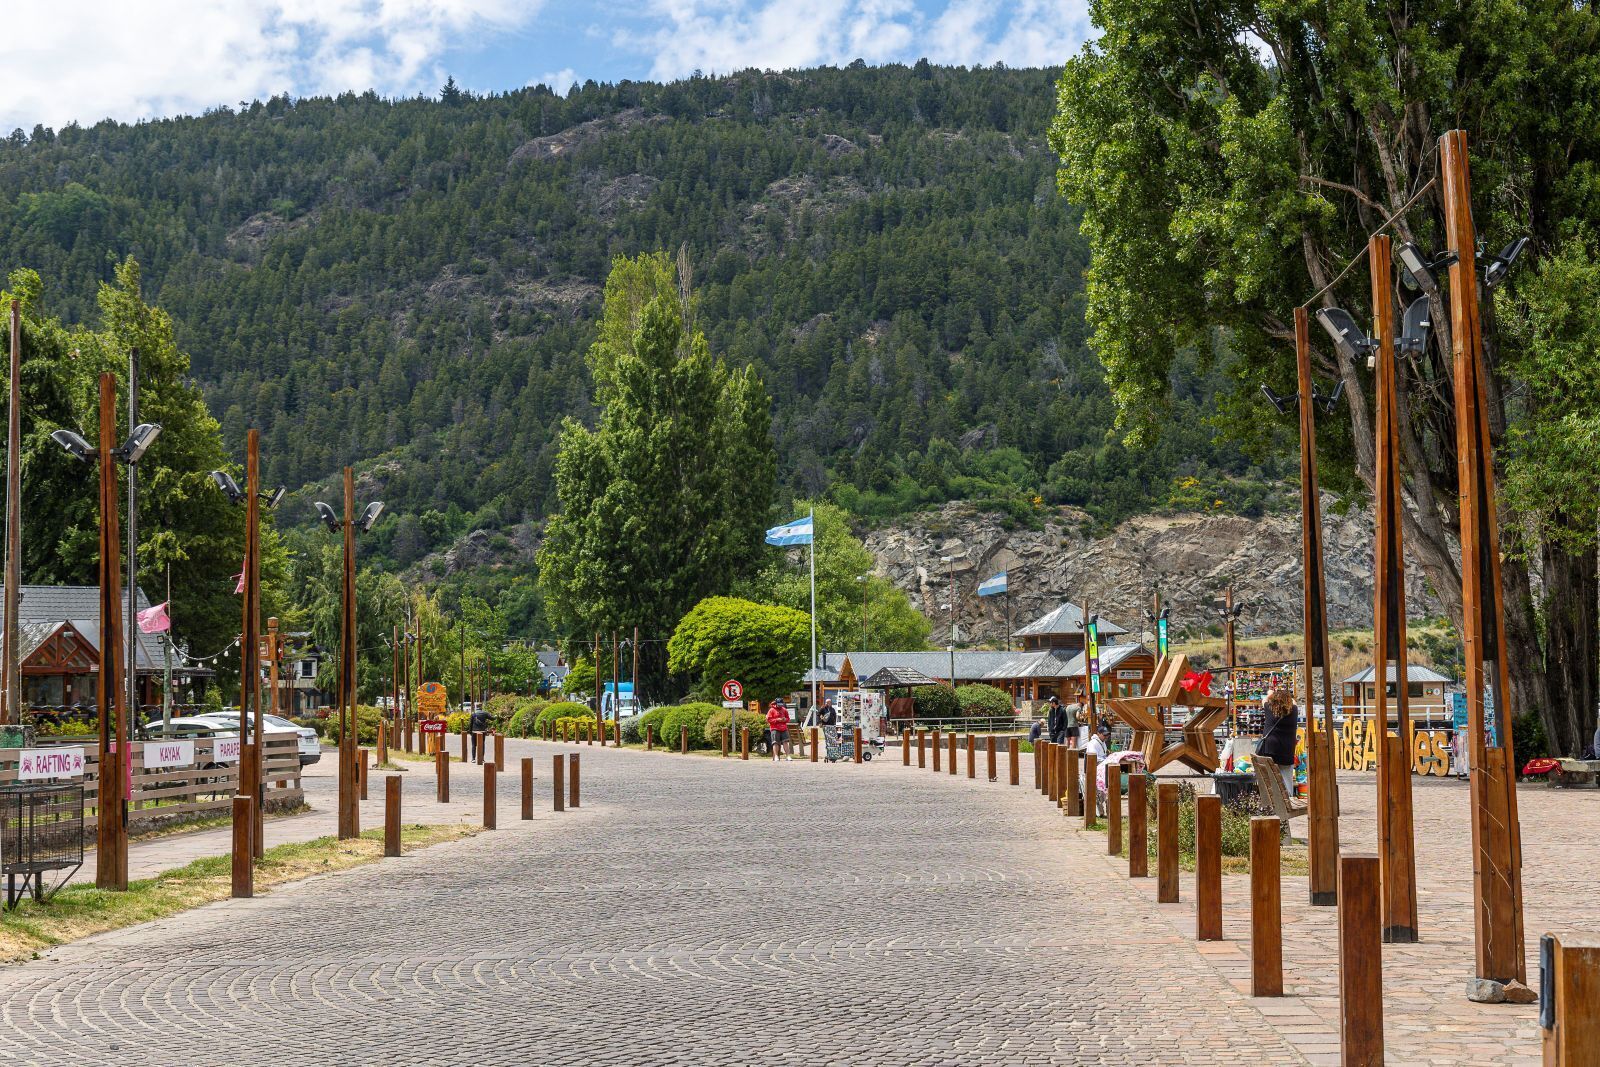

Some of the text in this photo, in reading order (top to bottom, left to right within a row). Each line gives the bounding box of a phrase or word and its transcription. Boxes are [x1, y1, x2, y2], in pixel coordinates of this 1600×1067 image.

[1342, 714, 1362, 746] de
[160, 746, 181, 762] KAYAK
[1363, 719, 1450, 777] Aes
[36, 753, 71, 774] RAFTING
